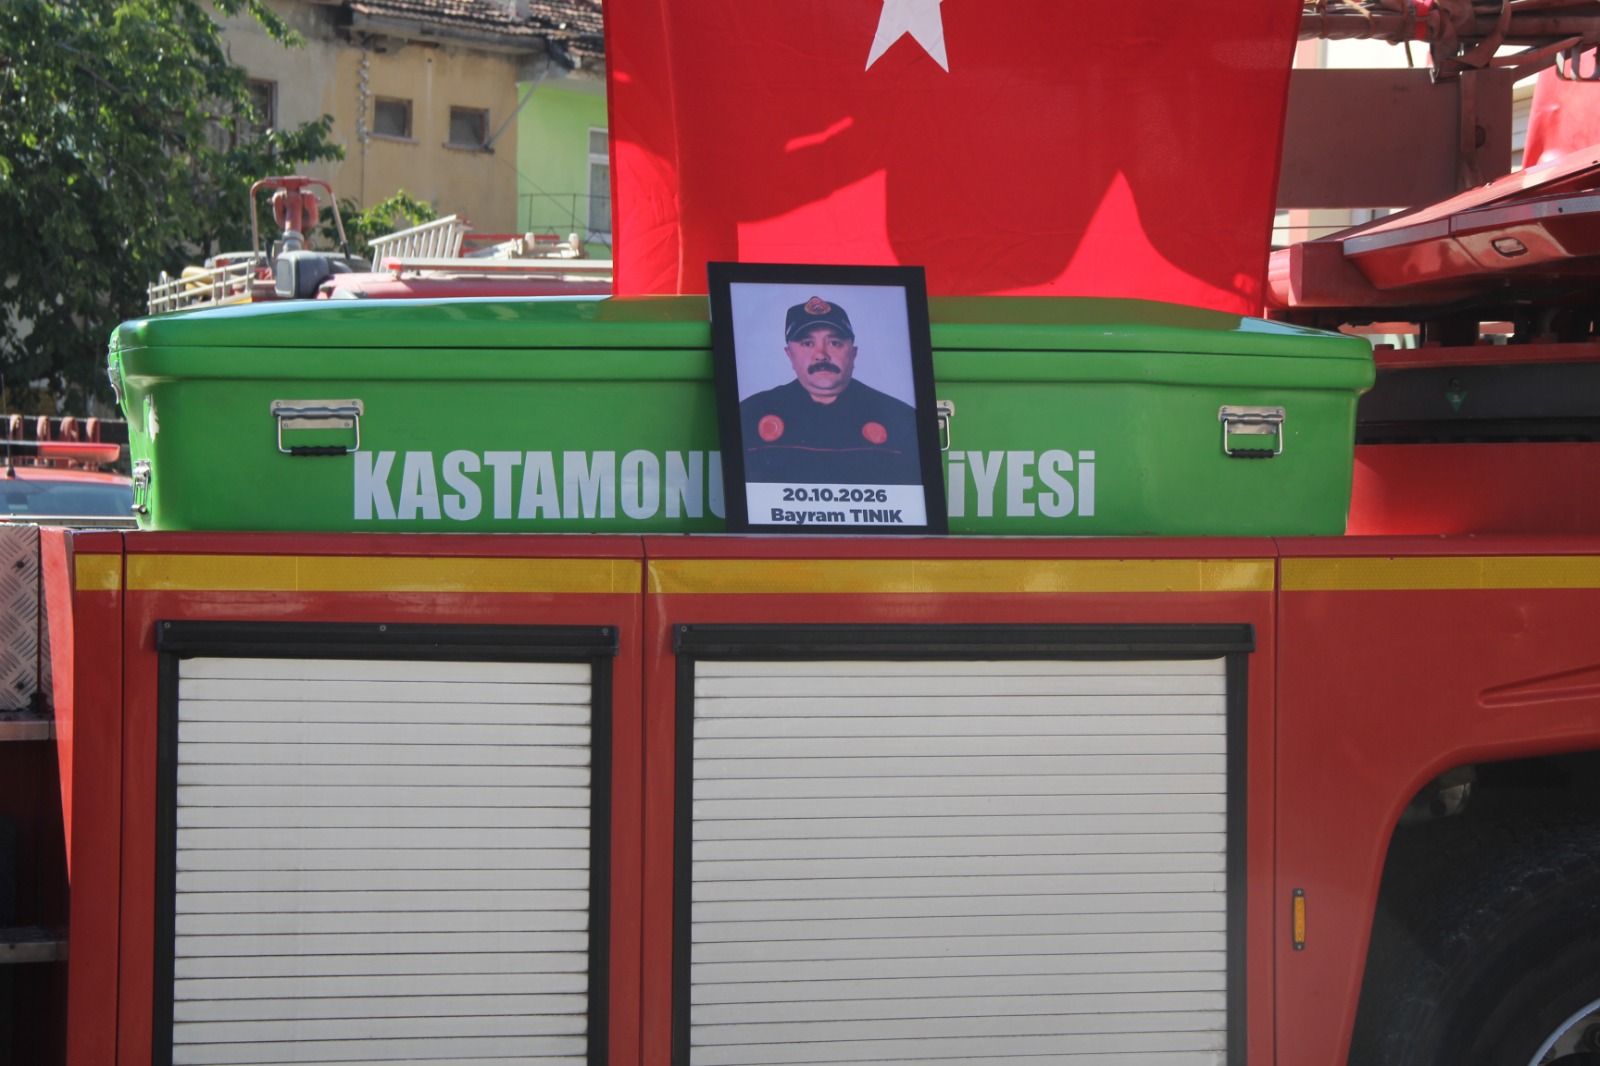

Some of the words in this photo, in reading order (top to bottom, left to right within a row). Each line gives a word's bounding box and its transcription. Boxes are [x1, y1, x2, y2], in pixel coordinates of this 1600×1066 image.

[783, 488, 888, 503] 20.10.2026
[771, 508, 845, 525] Bayram
[850, 509, 903, 523] TINIK
